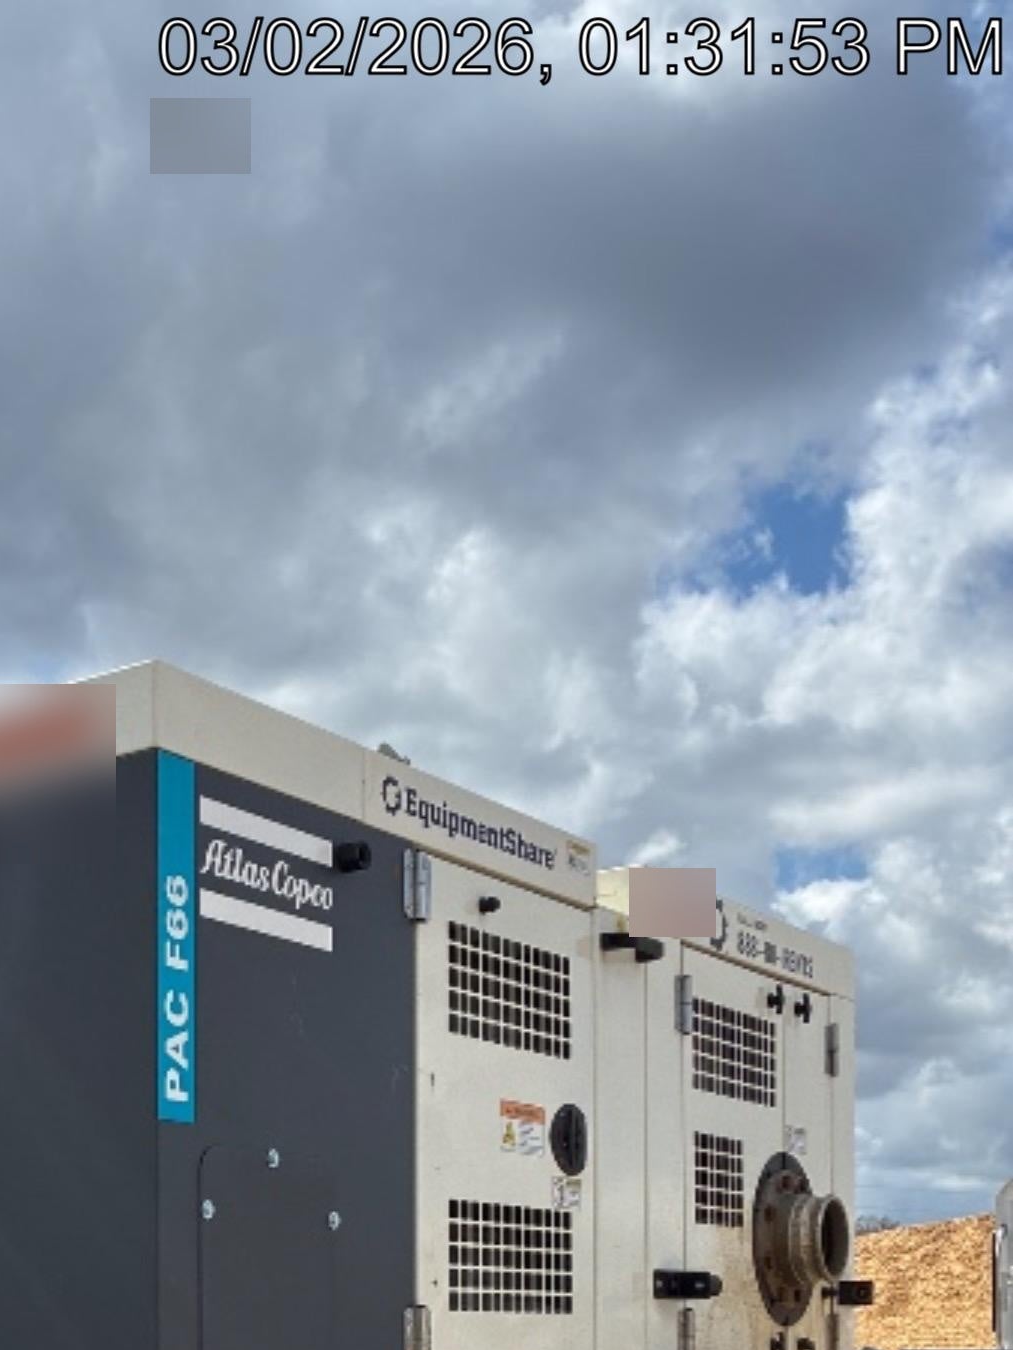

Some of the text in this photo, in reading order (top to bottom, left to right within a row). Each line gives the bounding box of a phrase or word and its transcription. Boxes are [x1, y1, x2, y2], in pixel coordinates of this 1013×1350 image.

[405, 786, 556, 870] EquipmentShare
[200, 839, 334, 910] Atlas Copco
[163, 874, 189, 1103] PAC F66
